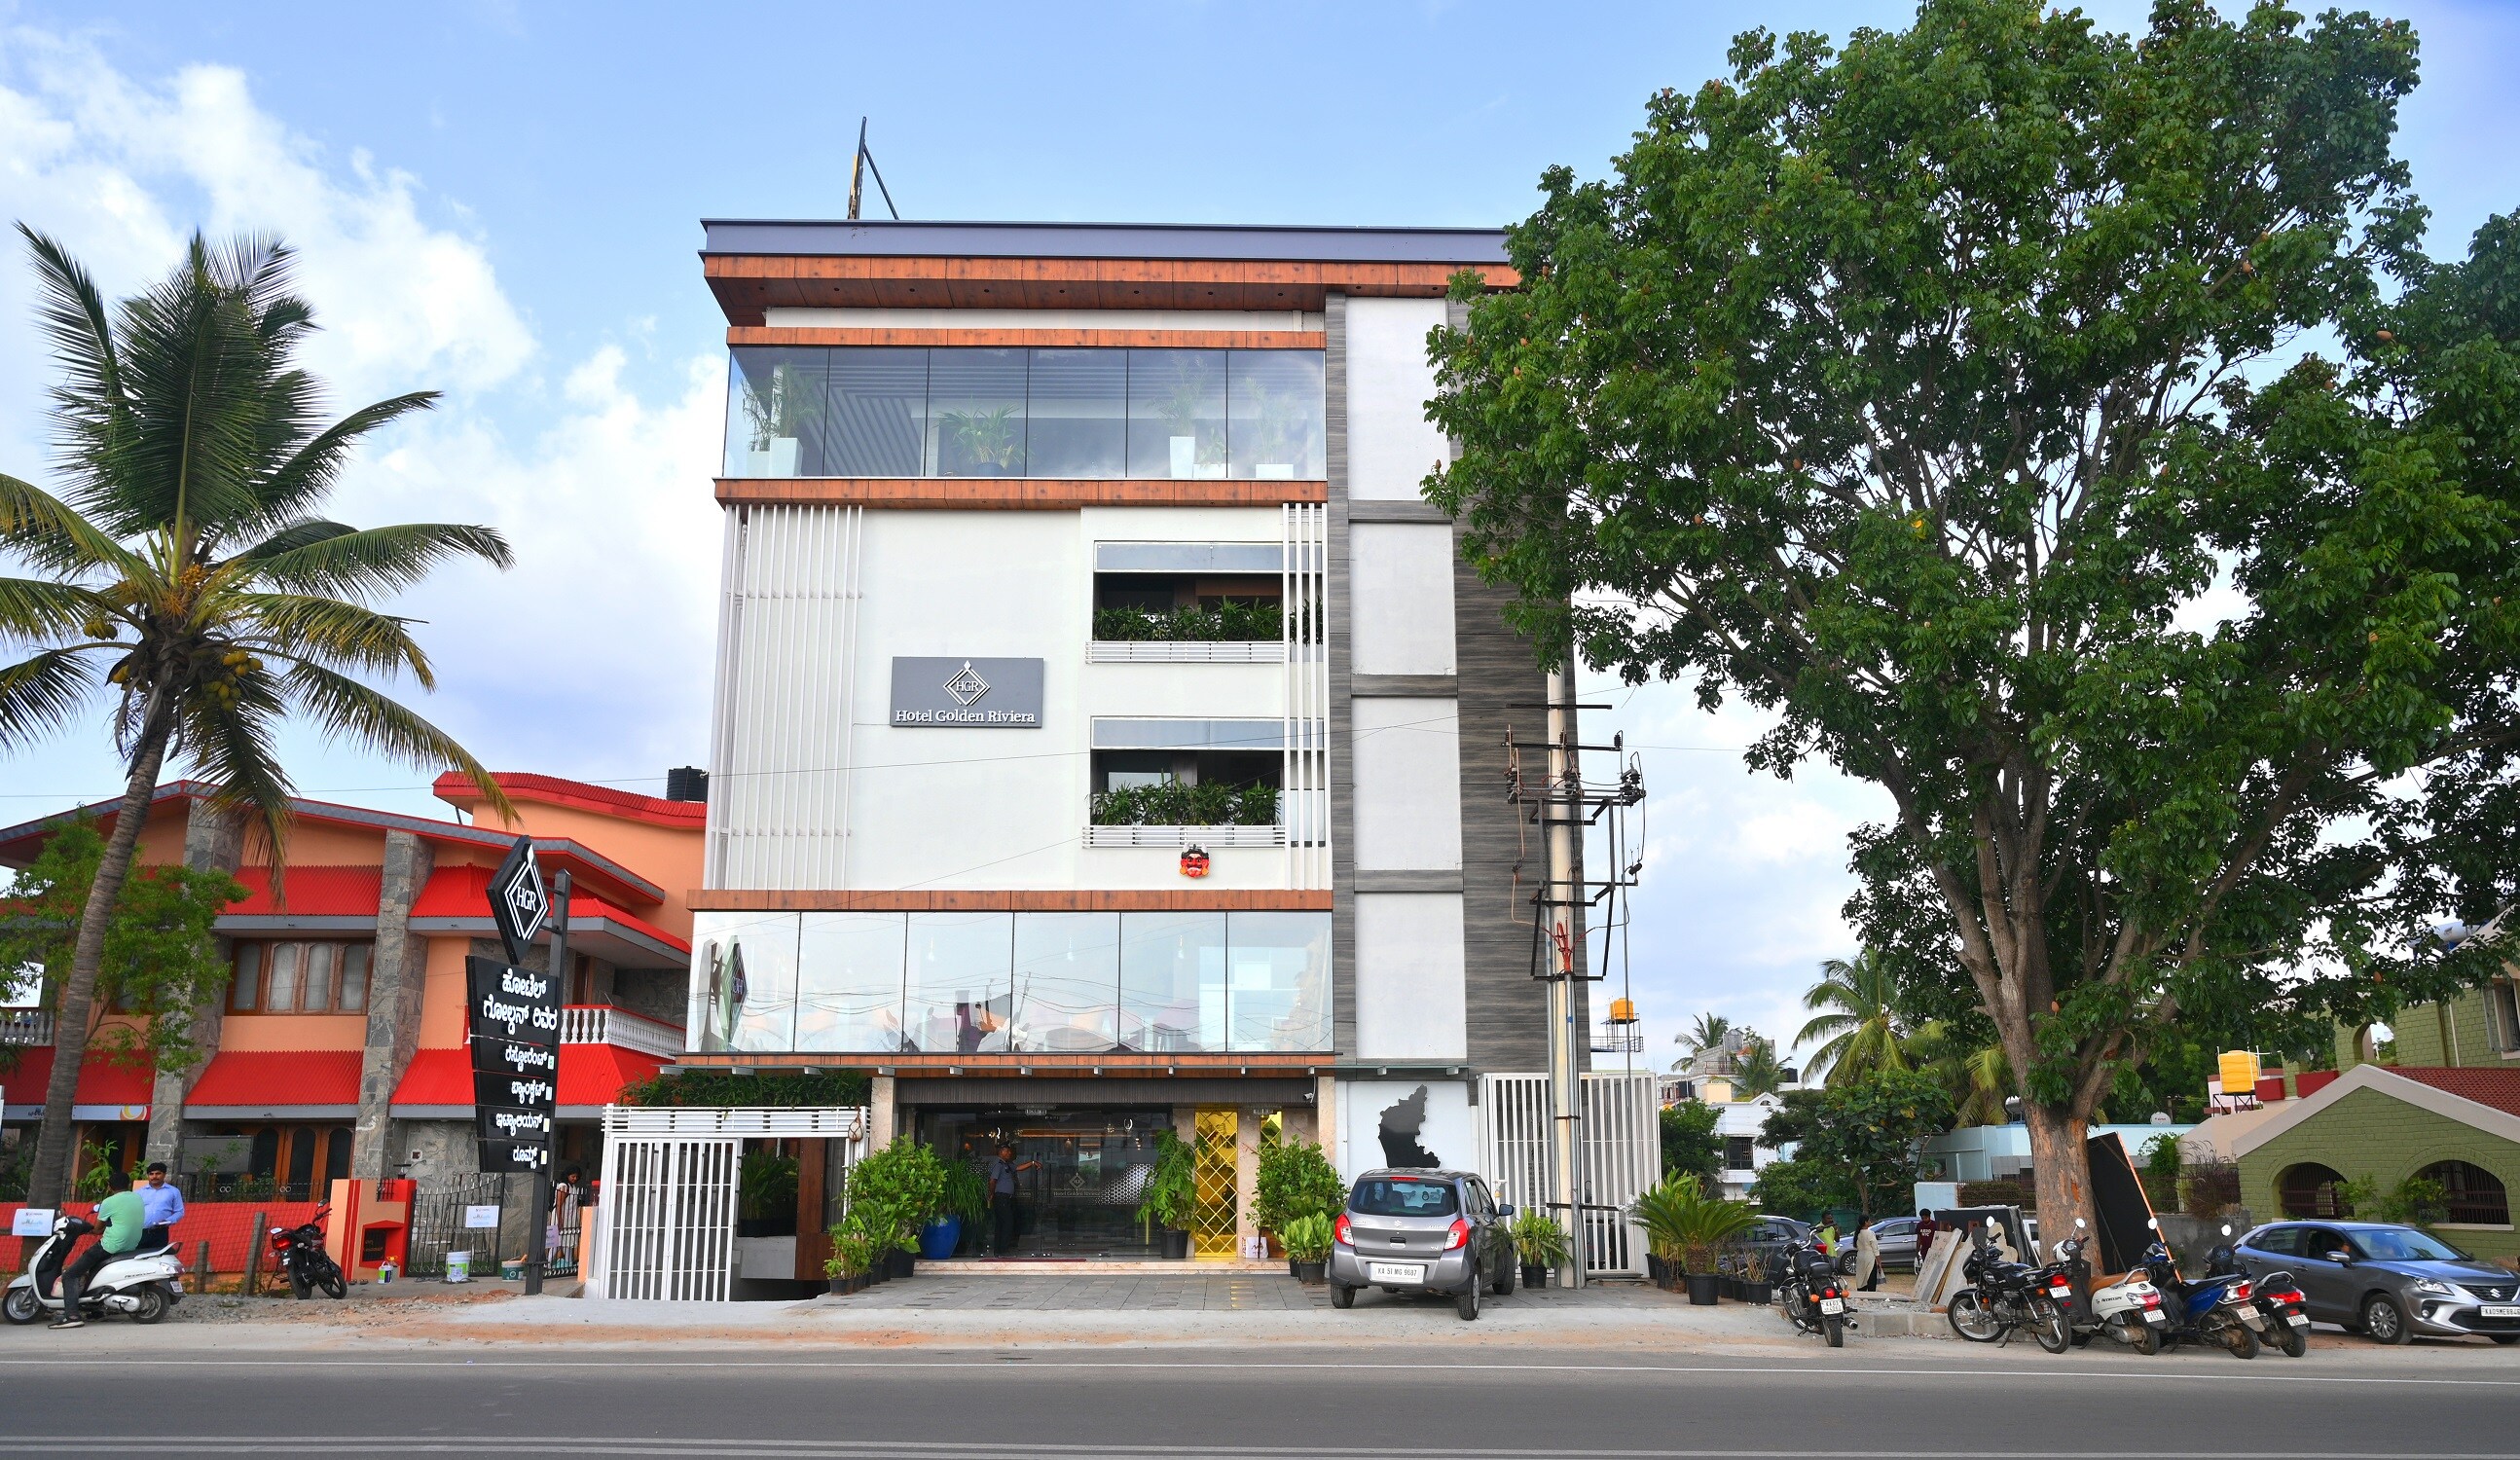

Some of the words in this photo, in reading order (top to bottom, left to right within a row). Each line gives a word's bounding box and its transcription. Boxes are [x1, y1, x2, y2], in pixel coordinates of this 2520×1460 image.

[956, 681, 979, 692] HGR
[895, 710, 932, 722] Hotel
[935, 710, 985, 722] Golden
[988, 711, 1036, 723] Riviera
[516, 886, 536, 913] HGR
[502, 967, 547, 999] ಹೋಟೆಲ್
